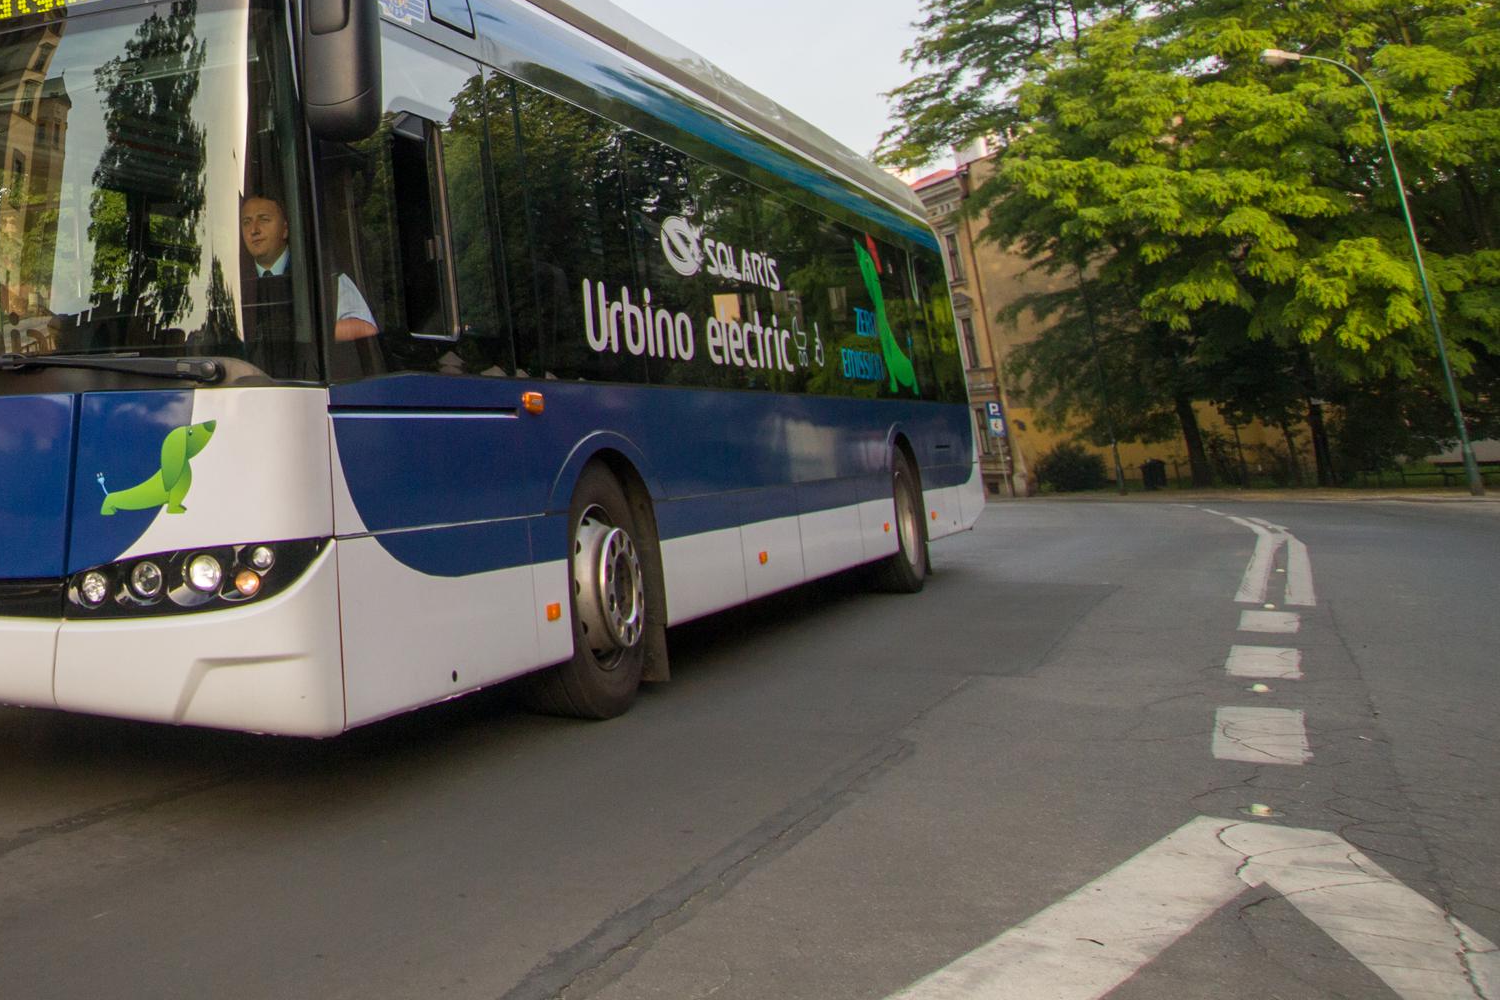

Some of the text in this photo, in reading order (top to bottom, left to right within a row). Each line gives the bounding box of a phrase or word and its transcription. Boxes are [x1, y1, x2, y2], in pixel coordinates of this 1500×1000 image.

[703, 237, 781, 291] SOLARIS
[582, 278, 795, 373] Urbino electric
[988, 402, 1000, 416] P
